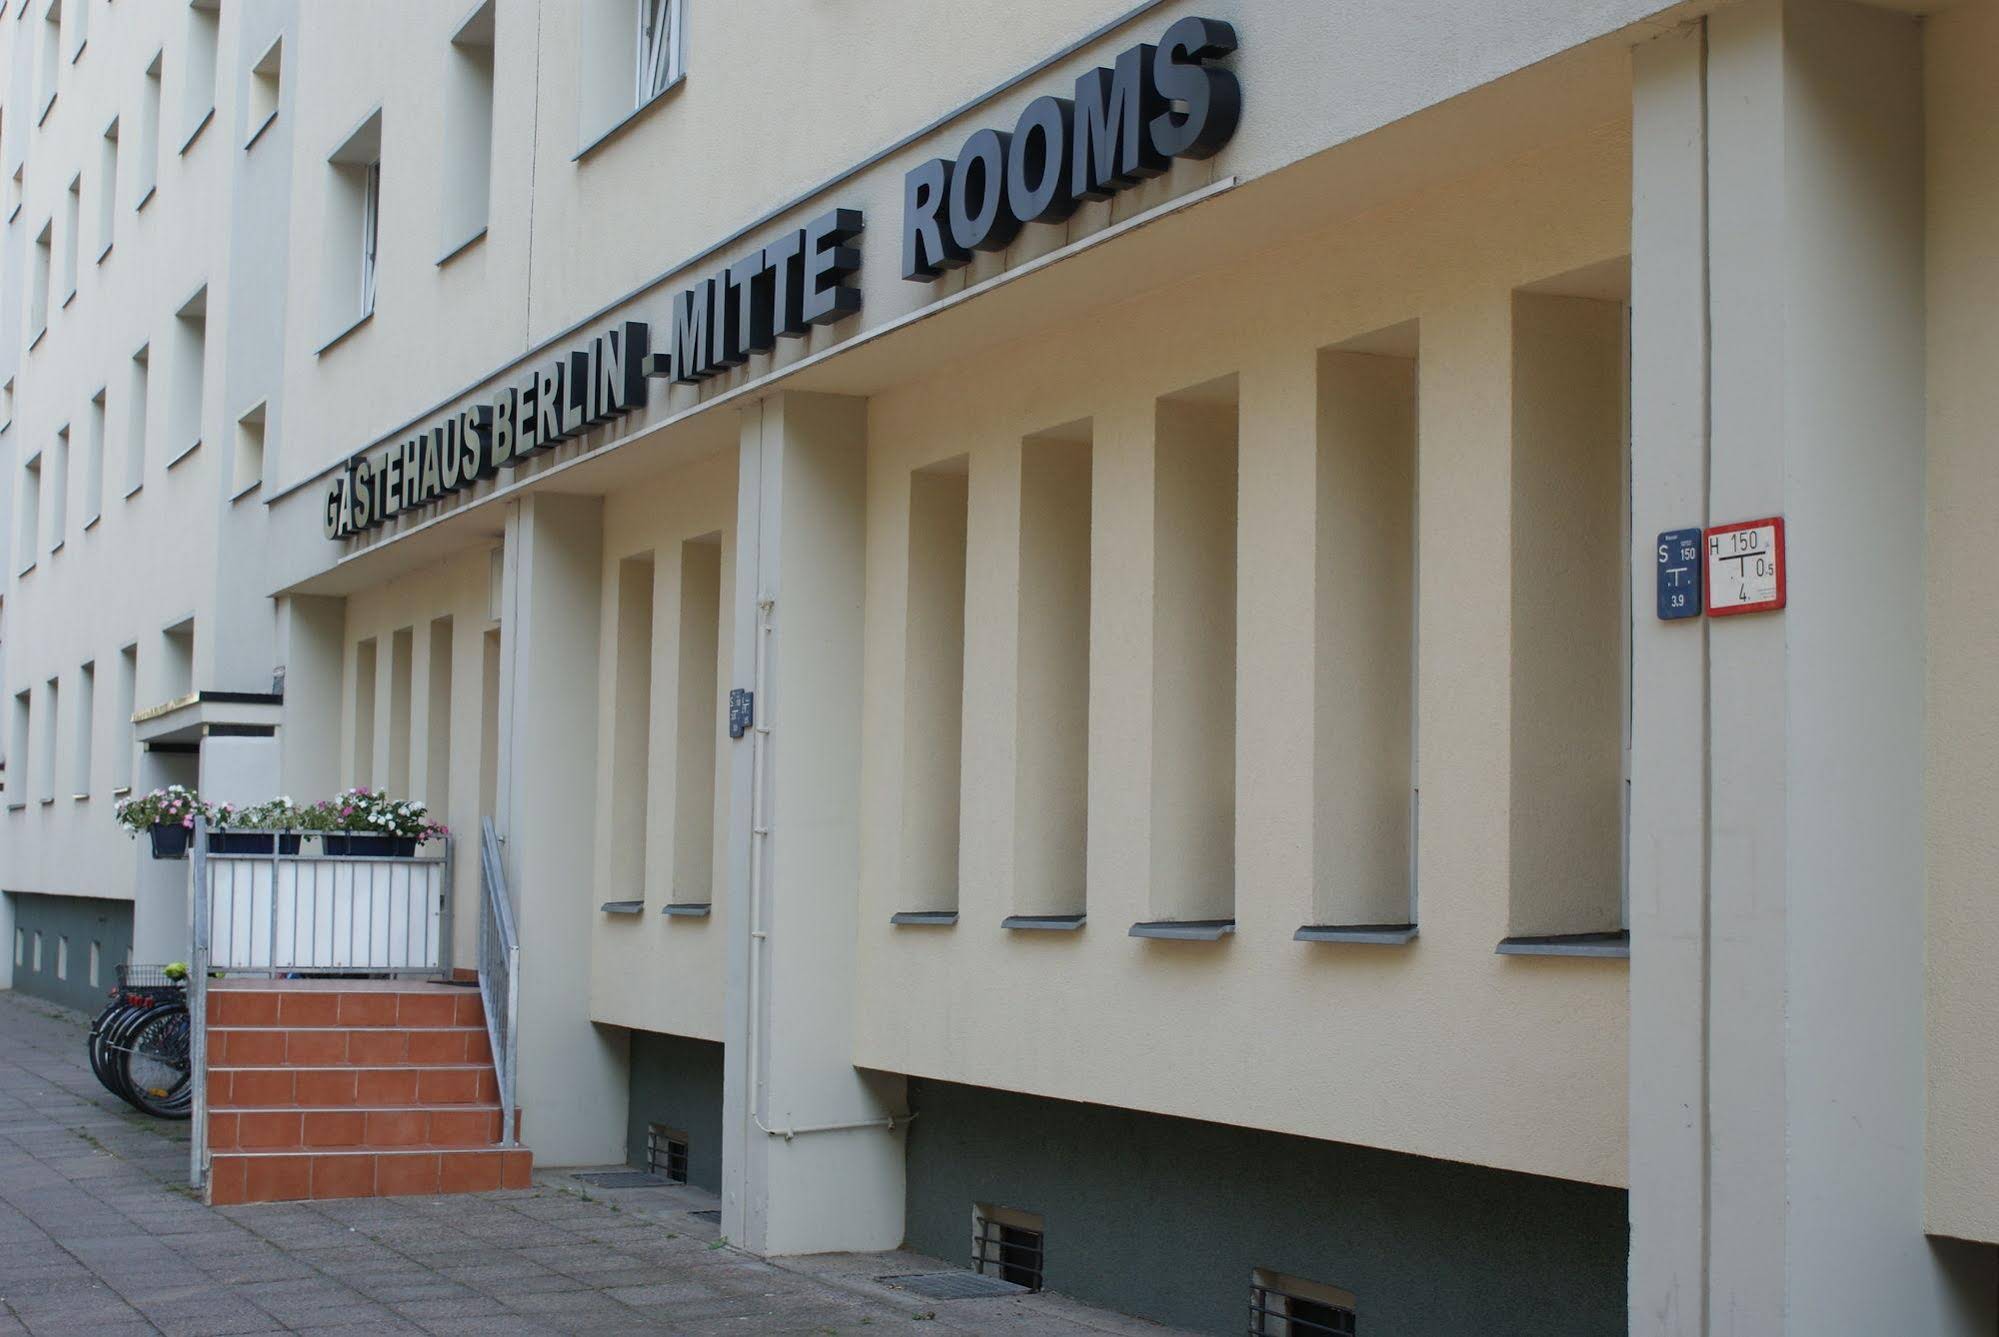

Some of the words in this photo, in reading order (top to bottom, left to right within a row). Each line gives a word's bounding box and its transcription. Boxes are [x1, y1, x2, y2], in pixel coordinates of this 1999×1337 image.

[491, 321, 648, 467] BERLIN
[671, 208, 863, 385] MITTE
[902, 16, 1241, 282] ROOMS
[1659, 544, 1669, 563] S
[1680, 547, 1696, 561] 150
[1709, 536, 1719, 556] H
[1731, 530, 1758, 553] 150
